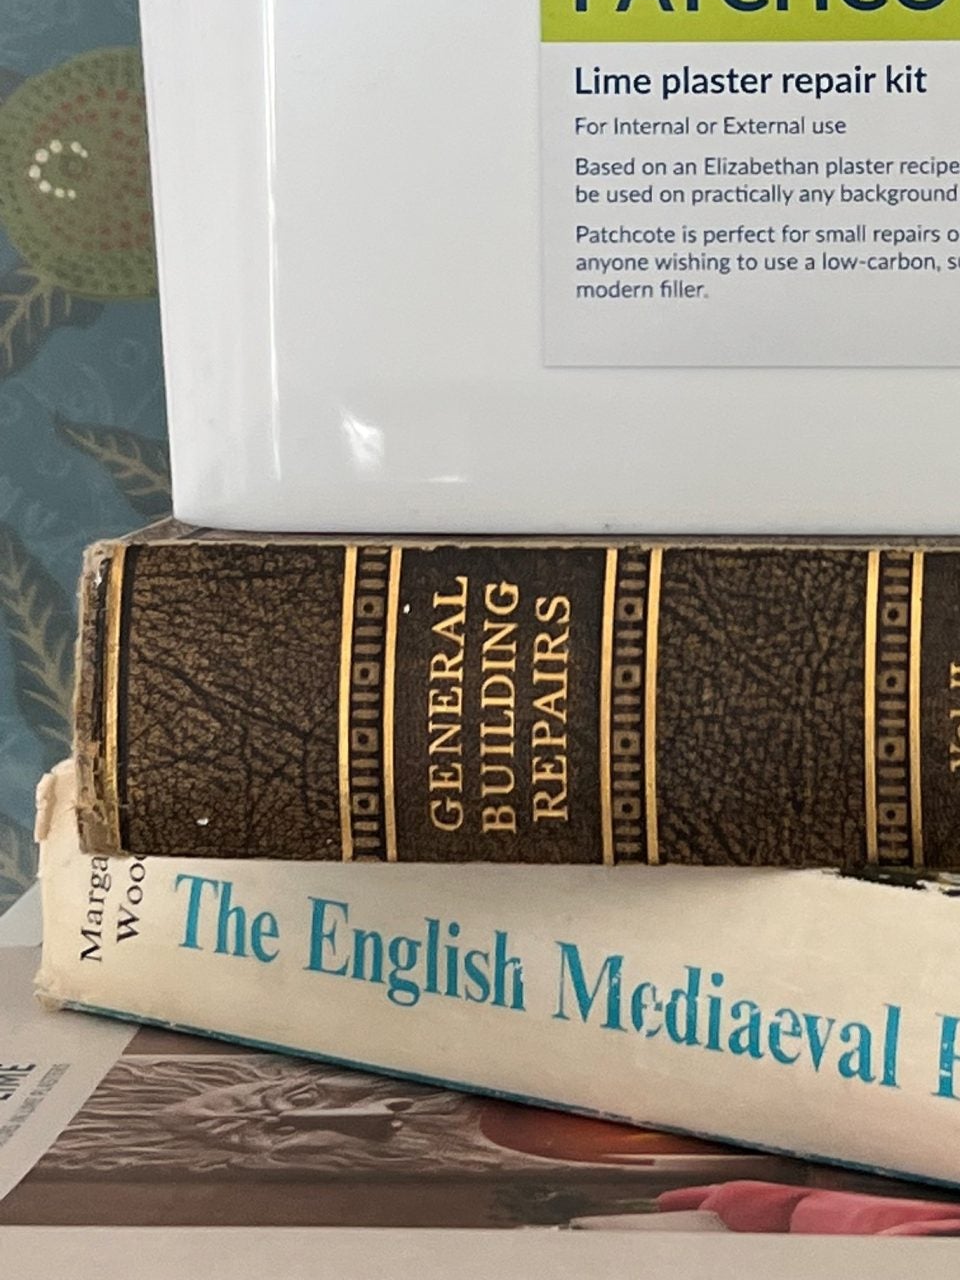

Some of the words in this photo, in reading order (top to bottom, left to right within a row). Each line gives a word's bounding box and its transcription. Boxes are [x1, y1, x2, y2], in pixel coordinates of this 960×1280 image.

[575, 66, 652, 95] Lime
[662, 65, 774, 101] plaster
[782, 64, 877, 100] repair
[886, 64, 928, 94] kit
[574, 116, 609, 136] For
[613, 116, 690, 136] Internal
[695, 121, 719, 135] or
[723, 115, 805, 135] External
[812, 120, 847, 135] use
[575, 156, 636, 176] Based
[641, 161, 667, 176] on
[672, 161, 698, 176] an
[704, 156, 820, 176] Elizabethan
[825, 156, 895, 179] plaster
[575, 184, 600, 204] be
[606, 184, 653, 204] used
[659, 189, 686, 204] on
[691, 183, 795, 207] practically
[798, 188, 836, 207] any
[840, 183, 959, 207] background
[575, 224, 676, 244] Patchcote
[681, 224, 698, 244] is
[703, 224, 776, 248] perfect
[781, 224, 812, 244] for
[814, 223, 867, 244] small
[872, 224, 941, 247] repairs
[575, 256, 649, 275] anyone
[654, 252, 732, 276] wishing
[736, 253, 759, 271] to
[764, 256, 799, 271] use
[804, 256, 816, 271] a
[822, 251, 942, 273] low-carbon,
[576, 279, 654, 299] modern
[659, 279, 709, 299] filler.
[428, 575, 468, 832] GENERAL
[480, 581, 520, 834] BUILDING
[532, 595, 571, 822] REPAIRS
[80, 855, 112, 962] Marga
[116, 855, 149, 944] Woo
[173, 873, 281, 964] The
[302, 895, 527, 1008] English
[551, 940, 902, 1090] Mediaeval
